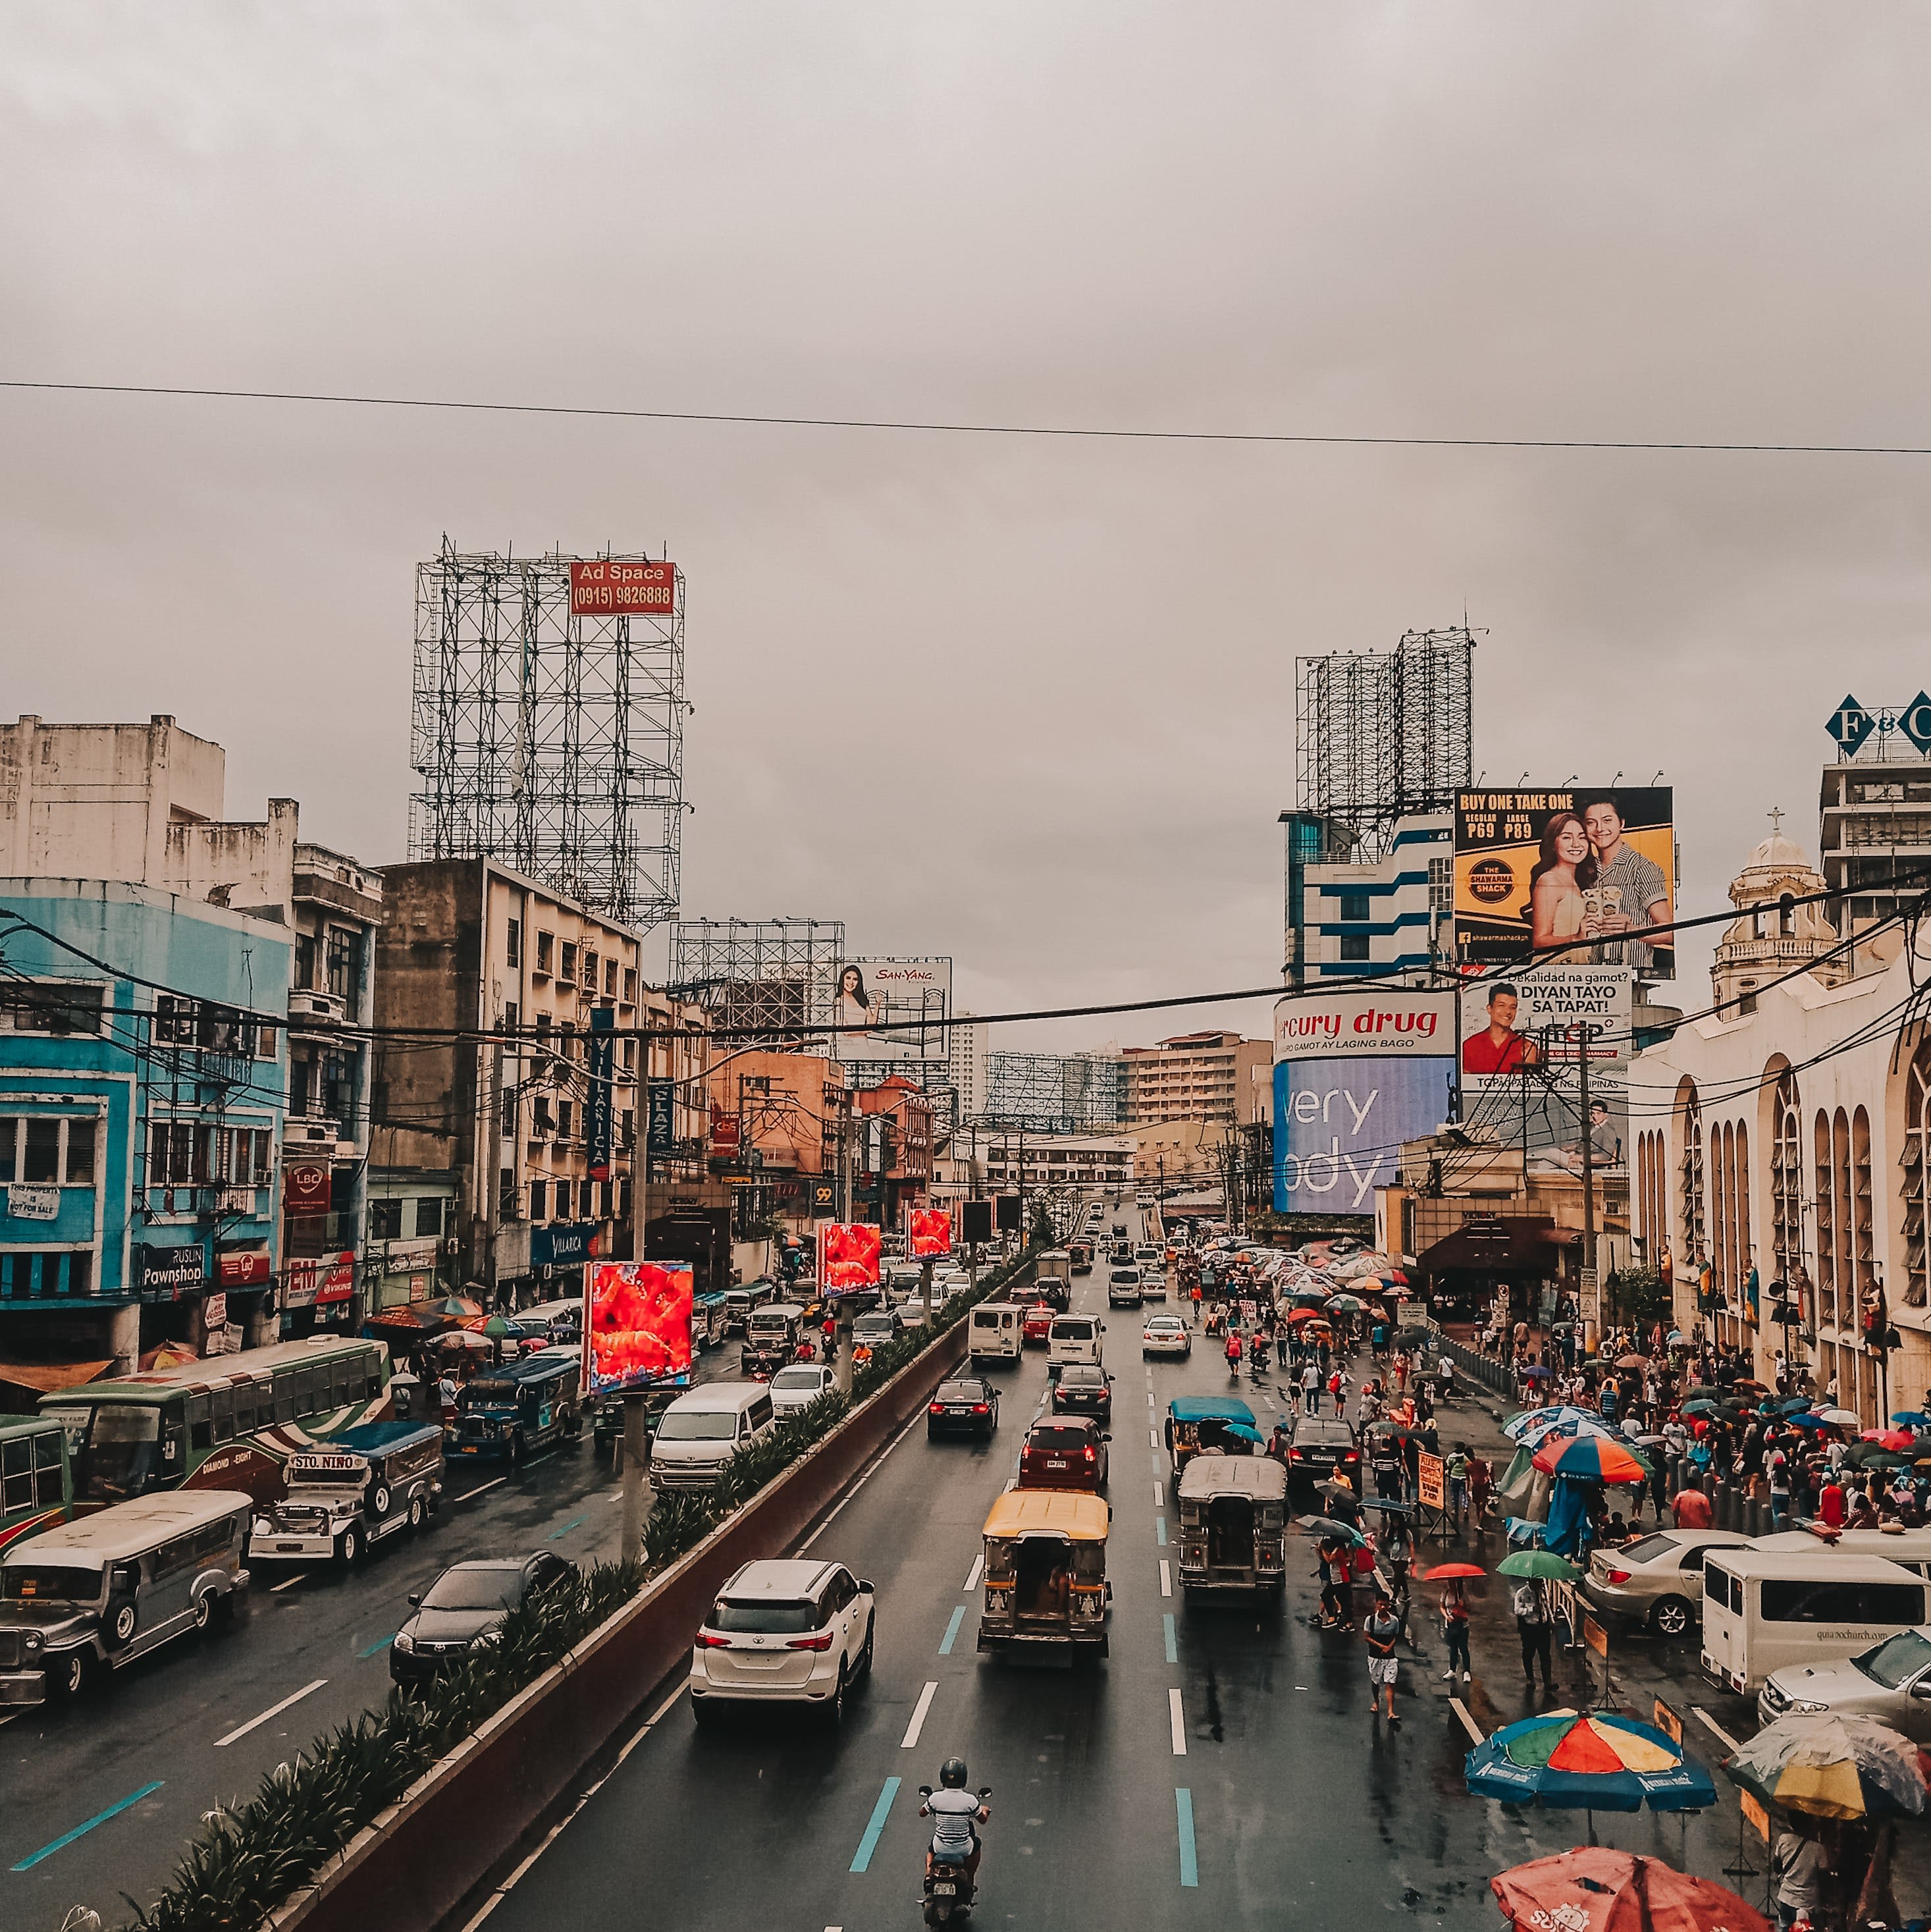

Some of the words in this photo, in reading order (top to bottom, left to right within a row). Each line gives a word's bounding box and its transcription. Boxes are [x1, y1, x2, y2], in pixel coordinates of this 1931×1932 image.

[579, 565, 604, 580] Ad
[610, 565, 664, 583] Space
[574, 586, 612, 610] (0915)
[616, 586, 670, 604] 9826888
[1836, 709, 1866, 742] F
[1460, 794, 1486, 811] BUY
[1488, 794, 1514, 810] ONE
[1515, 794, 1547, 810] TAKE
[1548, 793, 1574, 810] ONE
[1465, 813, 1497, 822] REGULAR
[1506, 814, 1529, 822] LARGE
[1470, 875, 1513, 884] SHAWARMA
[1585, 972, 1628, 984] gamot?
[1521, 986, 1572, 998] DIYAN
[1576, 986, 1616, 998] TAYO
[1532, 1000, 1553, 1013] SA
[1555, 1000, 1608, 1013] TAPAT!
[1353, 1008, 1439, 1038] drug
[1294, 1042, 1321, 1051] GAMOT
[1321, 1040, 1335, 1049] AY
[1336, 1039, 1377, 1049] LAGING
[1380, 1039, 1415, 1048] BAGO
[296, 1174, 319, 1184] LBC
[38, 1206, 53, 1214] SALE
[552, 1234, 582, 1259] VILLARICA
[172, 1248, 201, 1264] RUSLIN
[144, 1264, 201, 1286] Pawnshop
[331, 1282, 352, 1292] VIKING
[203, 1457, 230, 1475] DIAMOND
[296, 1455, 319, 1468] STO.
